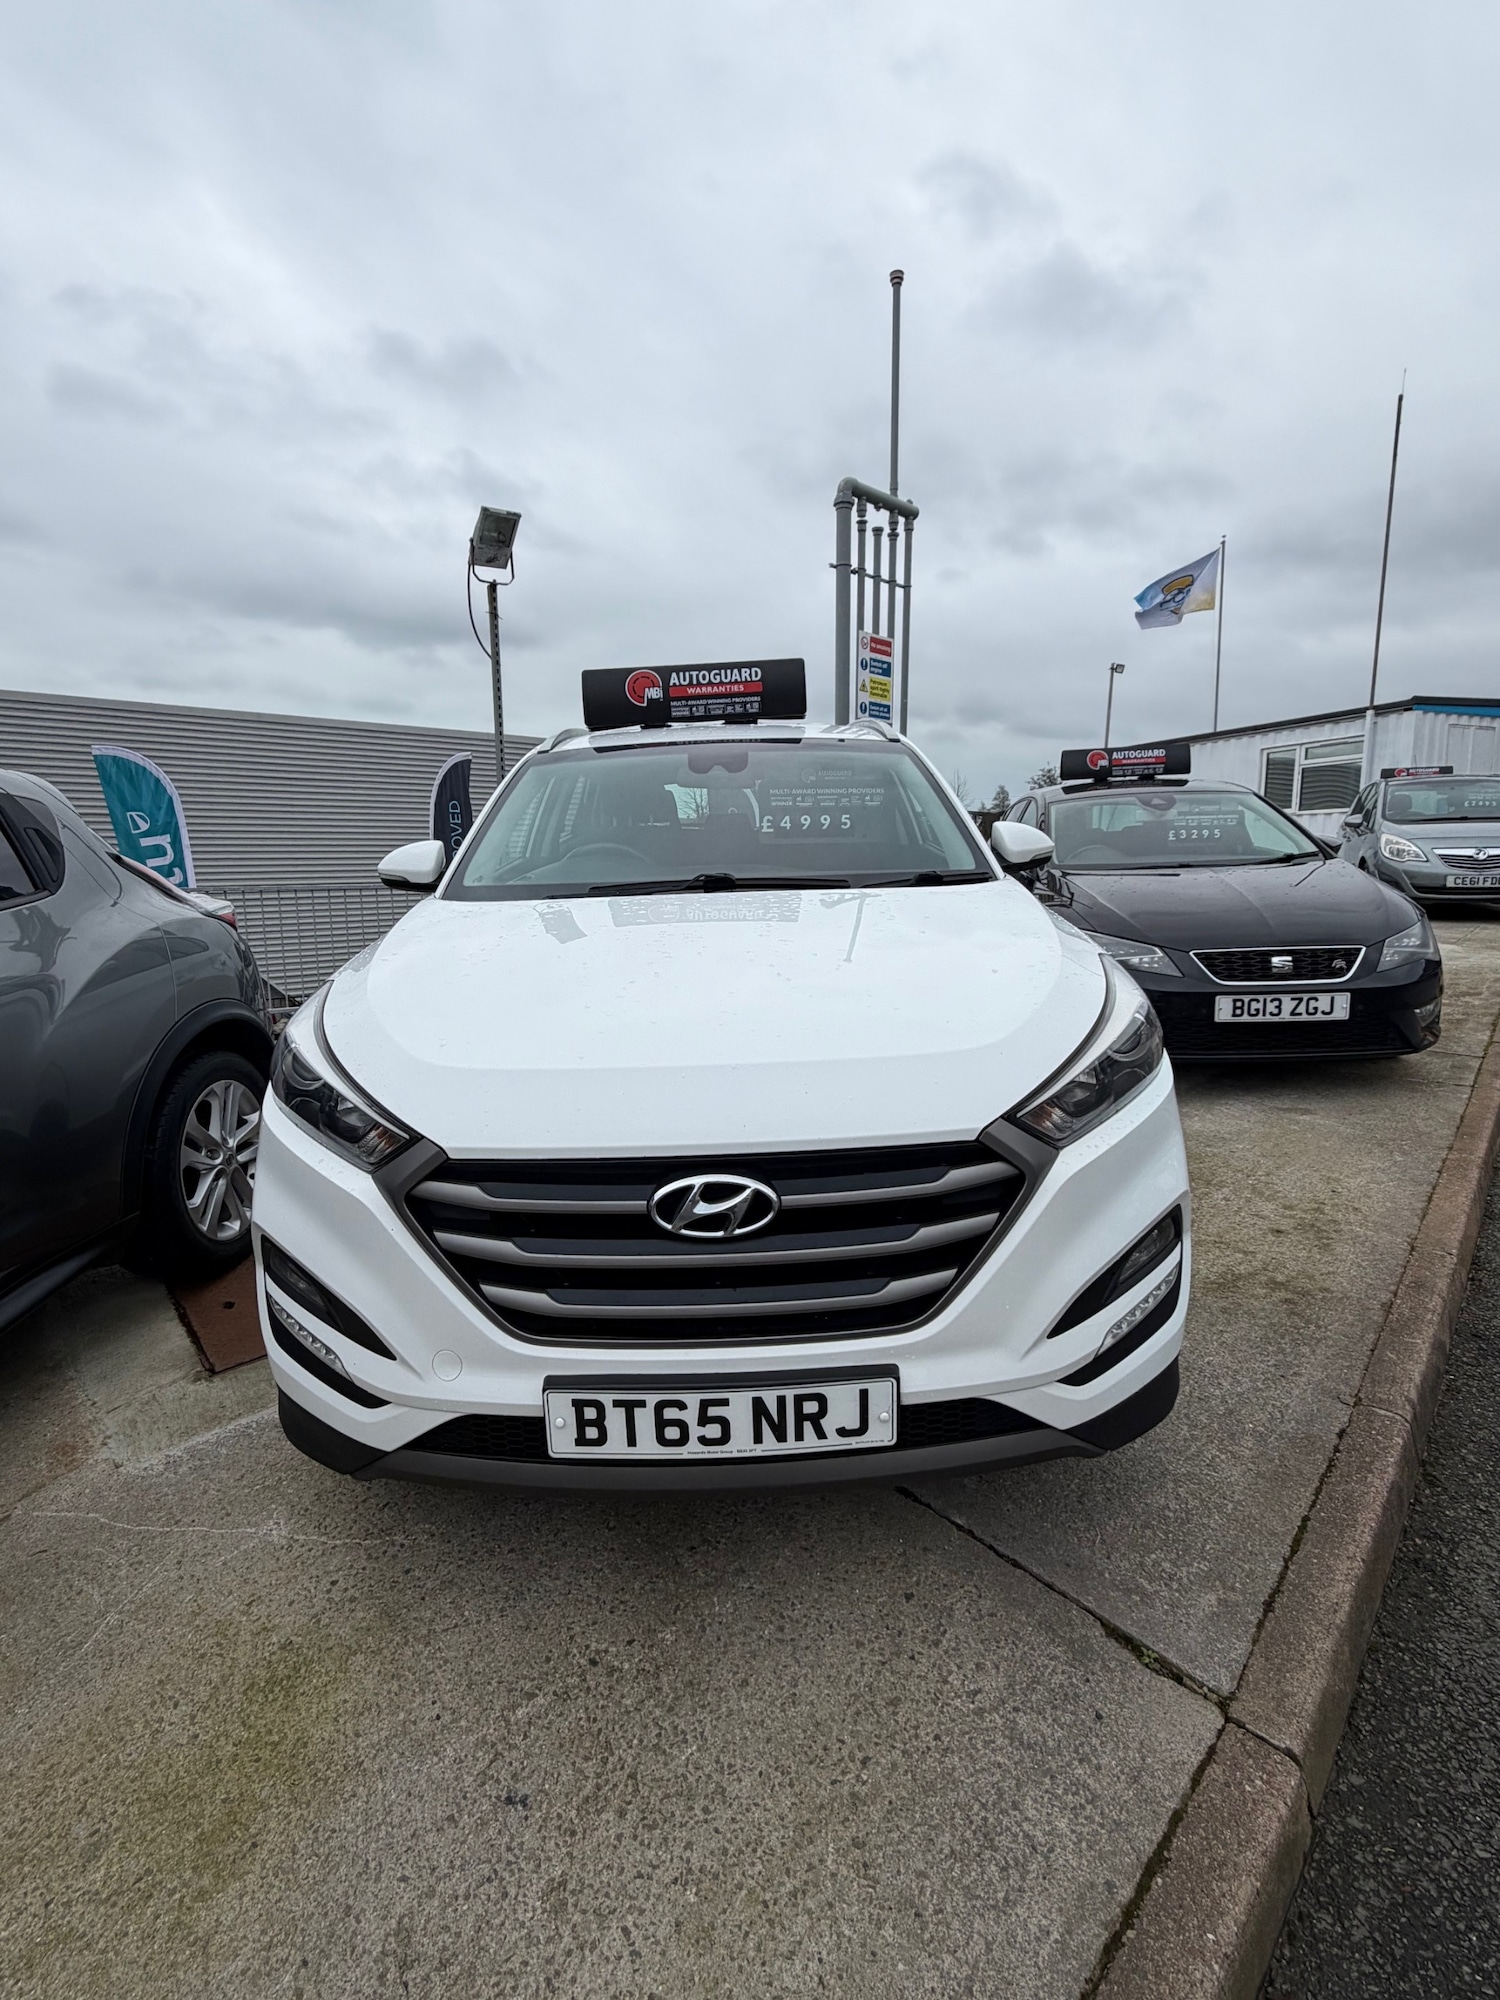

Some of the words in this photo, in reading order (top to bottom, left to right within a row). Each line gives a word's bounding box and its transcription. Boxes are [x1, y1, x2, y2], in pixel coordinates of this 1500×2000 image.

[669, 667, 762, 687] AUTOGUARD
[686, 684, 745, 695] WARRANTIES
[1112, 749, 1166, 760] AUTOGUARD
[1454, 876, 1480, 886] CE61
[1482, 876, 1500, 886] FD
[1231, 996, 1283, 1018] BG13
[1289, 995, 1335, 1017] ZGJ
[571, 1398, 732, 1448] BT65
[751, 1388, 870, 1445] NRJ
